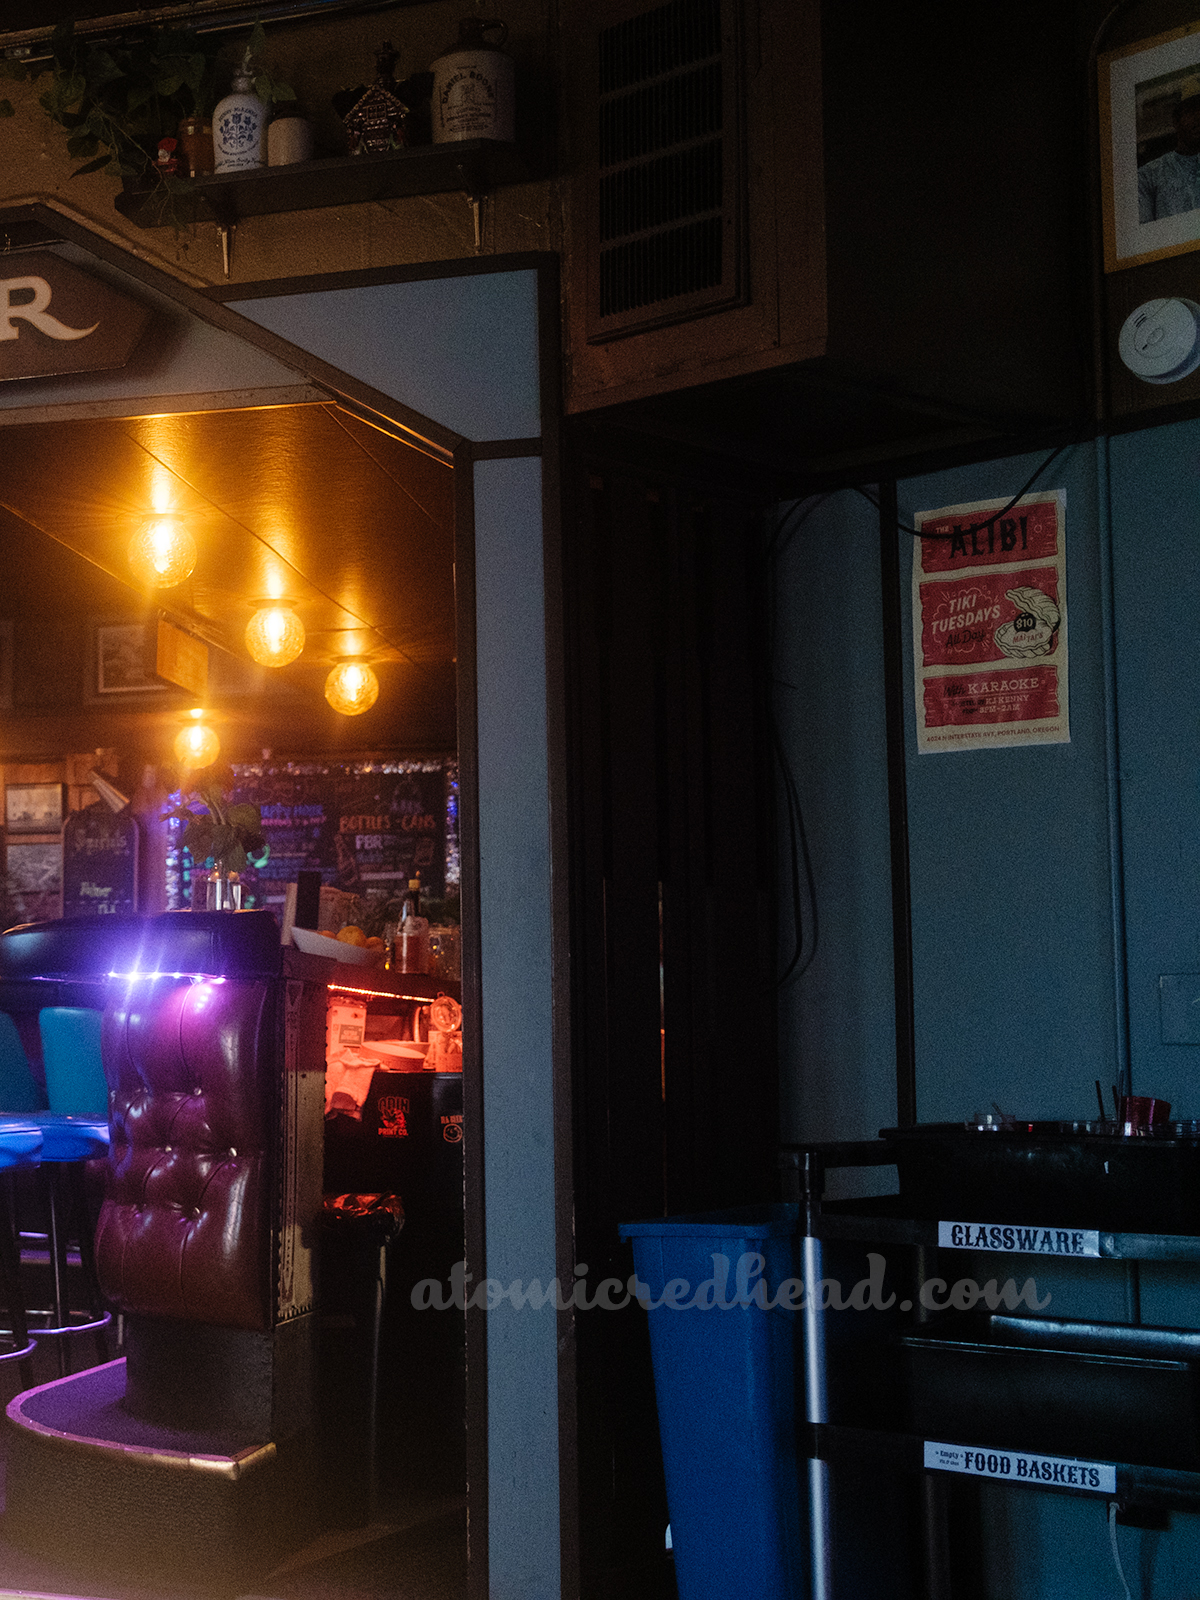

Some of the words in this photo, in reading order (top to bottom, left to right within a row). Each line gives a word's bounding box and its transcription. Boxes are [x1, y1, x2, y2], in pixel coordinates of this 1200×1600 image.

[936, 526, 949, 534] THE
[950, 516, 1028, 558] ALIBI
[949, 594, 977, 614] TIKI
[931, 605, 1001, 635] TUESDAYS
[1016, 617, 1034, 629] $10
[946, 631, 961, 647] All
[961, 629, 987, 642] Day
[968, 678, 1039, 695] KARAOKE
[1032, 726, 1060, 734] OREGON
[355, 834, 383, 850] PBR
[378, 1127, 397, 1135] PRINT
[951, 1224, 1084, 1254] GLASSWARE
[940, 1451, 960, 1459] Empty
[964, 1451, 1011, 1475] FOOD
[1017, 1458, 1101, 1488] BASKETS
